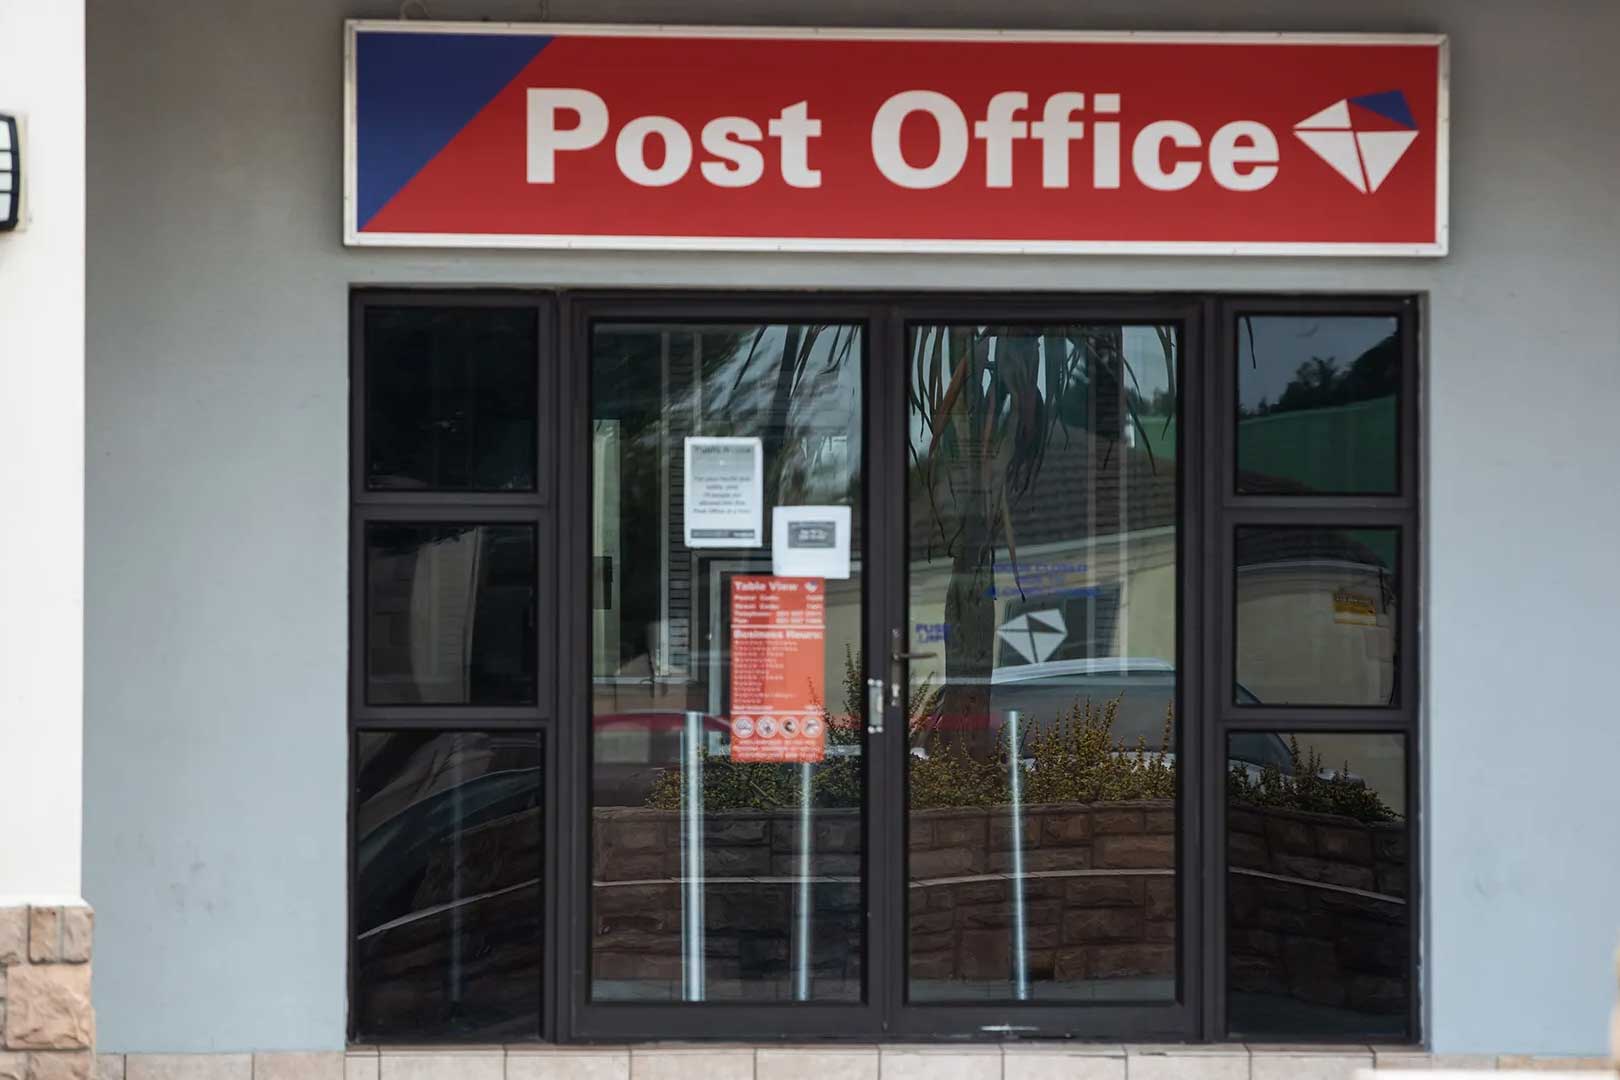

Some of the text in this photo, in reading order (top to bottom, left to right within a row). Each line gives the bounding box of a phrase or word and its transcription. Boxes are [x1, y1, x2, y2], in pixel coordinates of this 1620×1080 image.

[526, 88, 1280, 192] Post Office
[734, 581, 798, 591] Table View
